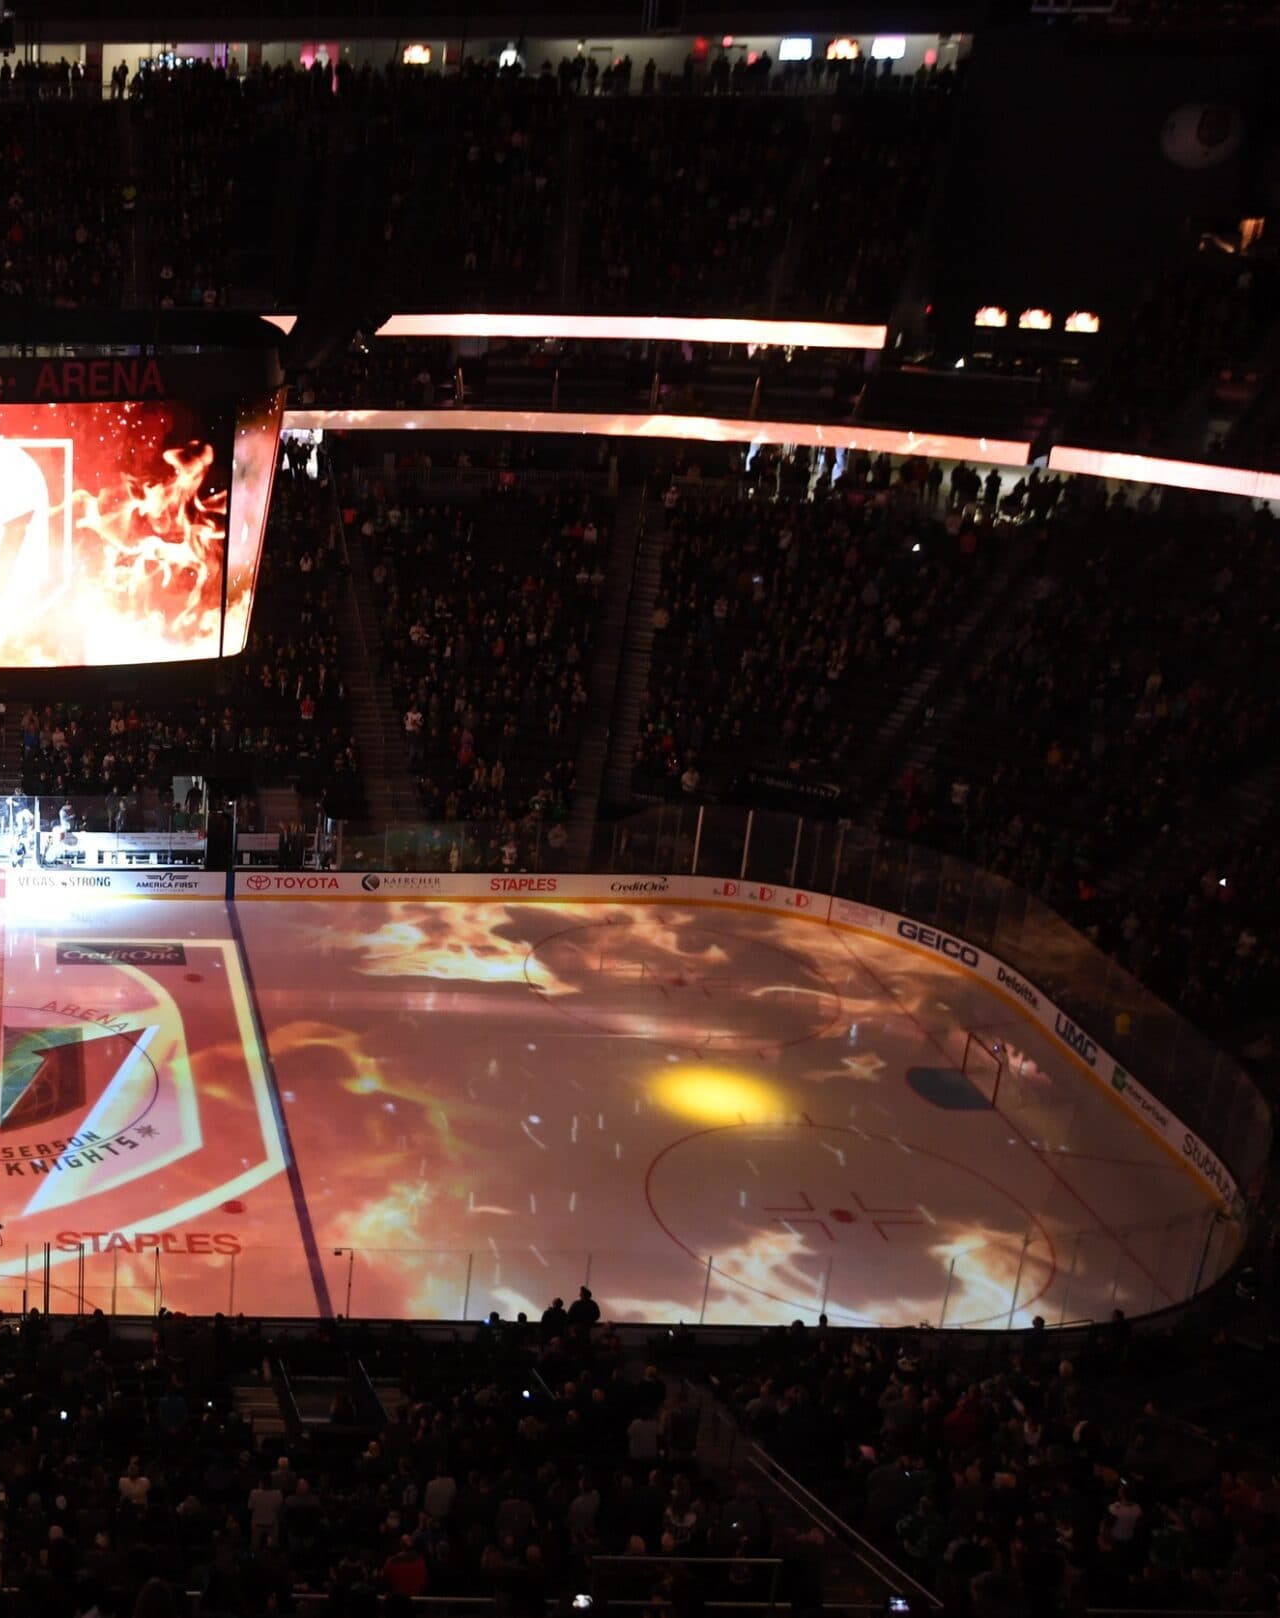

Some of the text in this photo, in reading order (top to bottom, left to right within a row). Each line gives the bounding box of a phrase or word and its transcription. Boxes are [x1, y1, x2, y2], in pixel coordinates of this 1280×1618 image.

[32, 360, 165, 396] ARENA
[68, 877, 112, 888] STRONG
[274, 877, 340, 889] TOYOTA
[490, 879, 557, 891] STAPLES
[897, 920, 979, 967] GEICO
[41, 1001, 130, 1034] ARENA
[1054, 1012, 1097, 1067] UMC
[1, 1131, 101, 1159] SEASON
[4, 1136, 139, 1177] KNIGHTS
[56, 1231, 242, 1255] STAPLES
